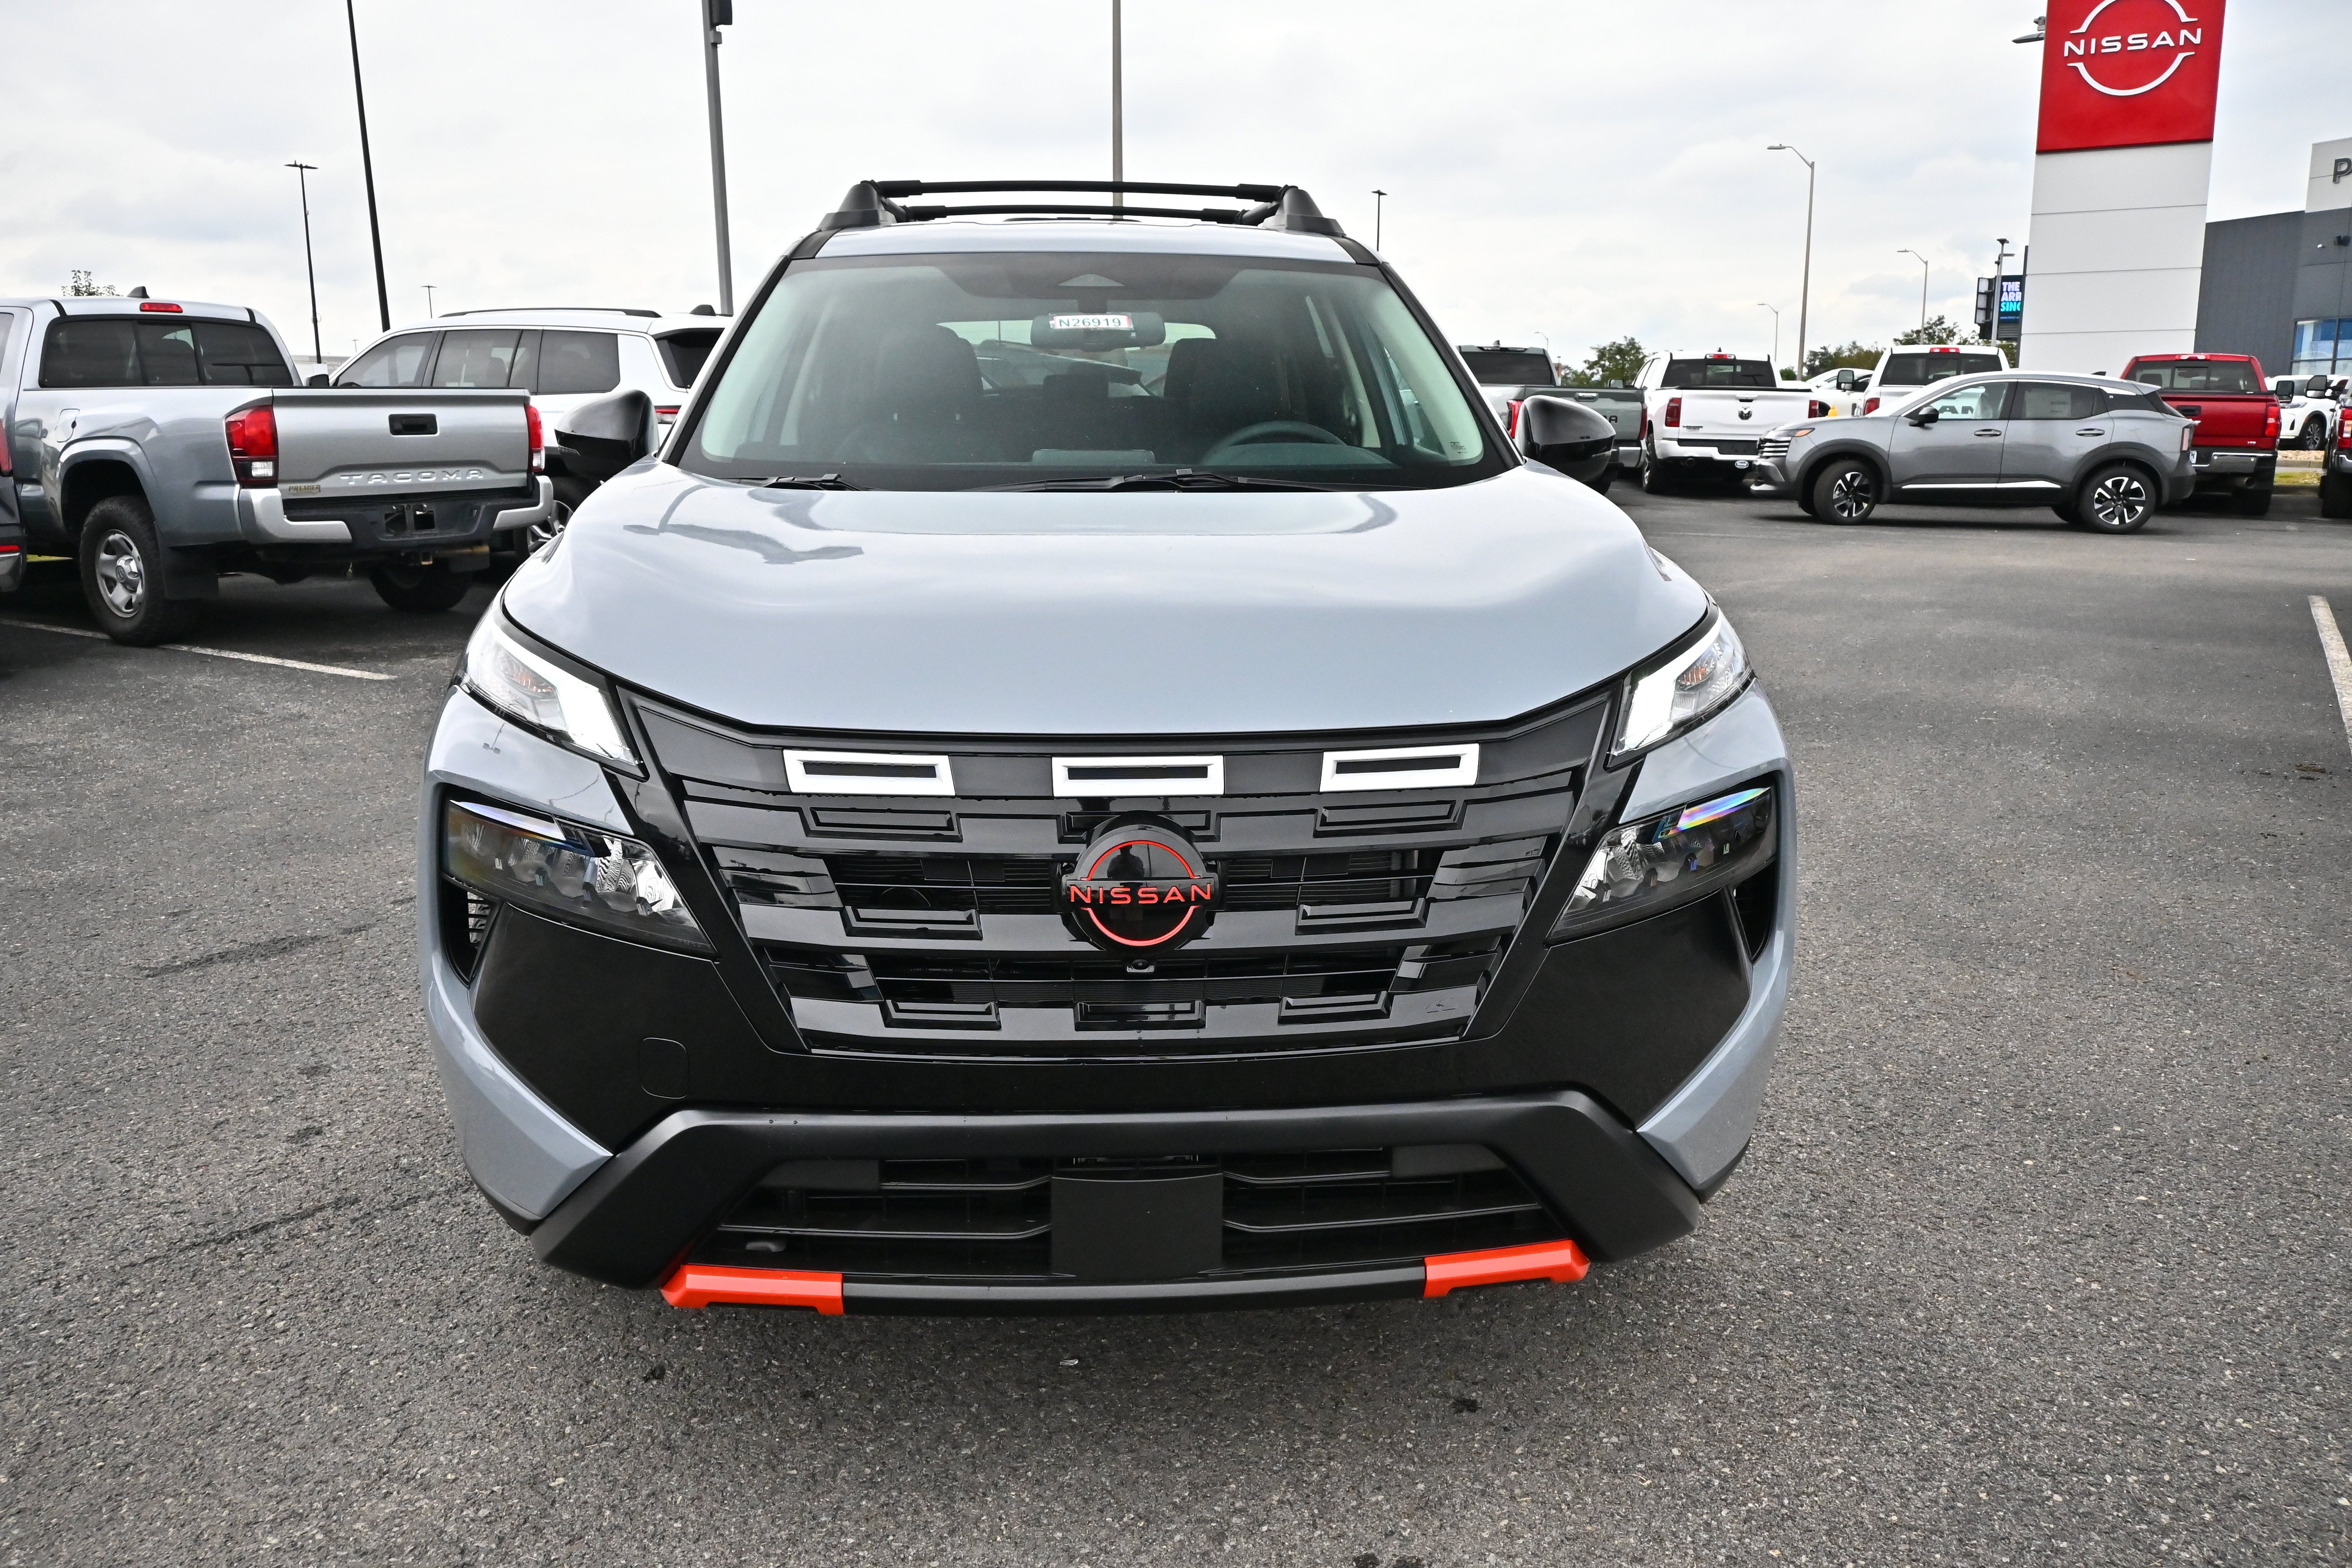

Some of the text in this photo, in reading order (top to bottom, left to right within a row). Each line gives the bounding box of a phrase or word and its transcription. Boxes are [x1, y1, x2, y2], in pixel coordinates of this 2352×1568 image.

[2064, 28, 2201, 57] NISSAN
[2002, 281, 2020, 292] THE
[1059, 318, 1121, 327] N26919
[340, 469, 483, 485] TACOMA
[289, 485, 321, 493] PREMIER
[1070, 882, 1211, 904] NISSAN
